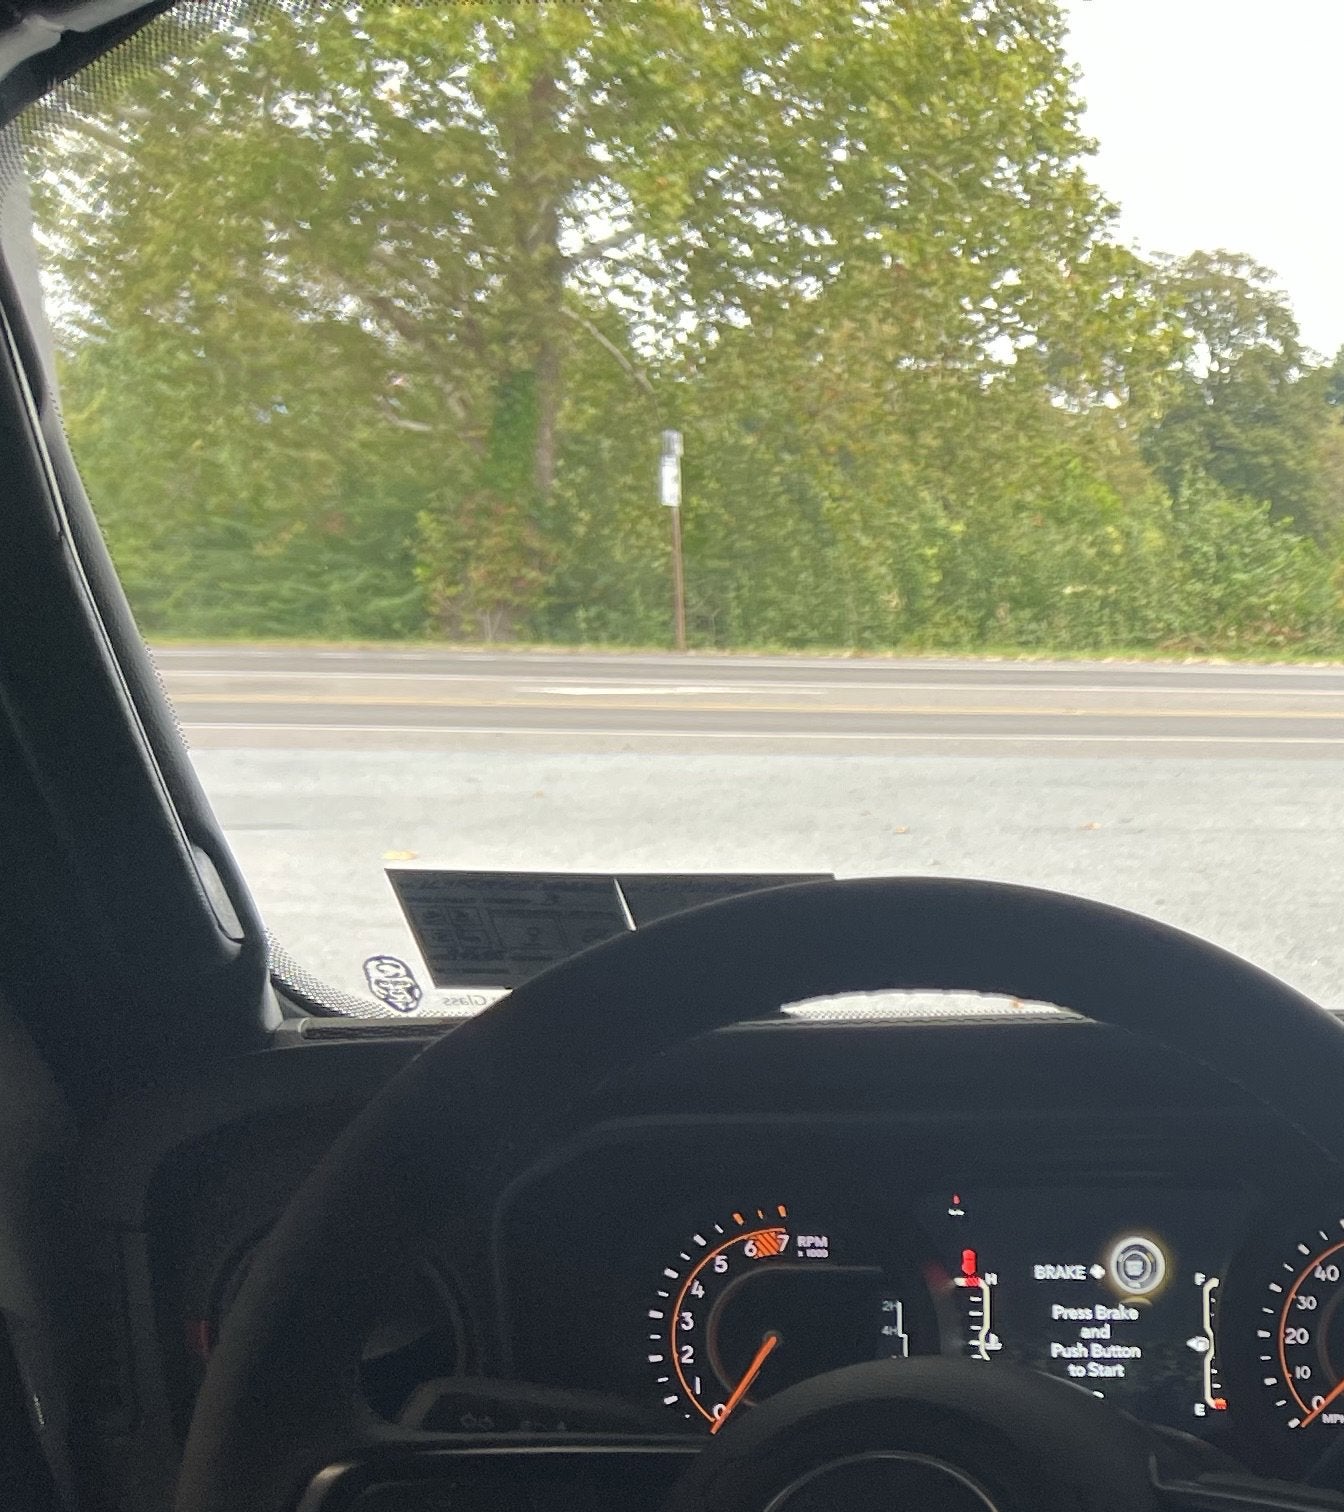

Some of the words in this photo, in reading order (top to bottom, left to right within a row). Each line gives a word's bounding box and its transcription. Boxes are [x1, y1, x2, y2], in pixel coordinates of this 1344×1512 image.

[744, 1238, 758, 1257] 6
[777, 1234, 790, 1252] 7
[797, 1235, 829, 1248] RPM
[714, 1255, 729, 1274] 5
[1033, 1264, 1087, 1280] BRAKE
[1314, 1264, 1340, 1282] 40
[690, 1280, 705, 1299] 4
[1296, 1295, 1318, 1310] 30
[1051, 1304, 1093, 1320] Press
[1095, 1304, 1140, 1320] Brake
[680, 1311, 695, 1331] 3
[1080, 1323, 1111, 1340] and
[1284, 1327, 1310, 1345] 20
[681, 1345, 694, 1364] 2
[1051, 1342, 1087, 1358] Push
[1089, 1342, 1142, 1358] Button
[1067, 1363, 1086, 1377] to
[1087, 1361, 1125, 1378] Start
[1295, 1365, 1312, 1380] 10
[694, 1375, 702, 1395] 1
[1194, 1403, 1206, 1417] E
